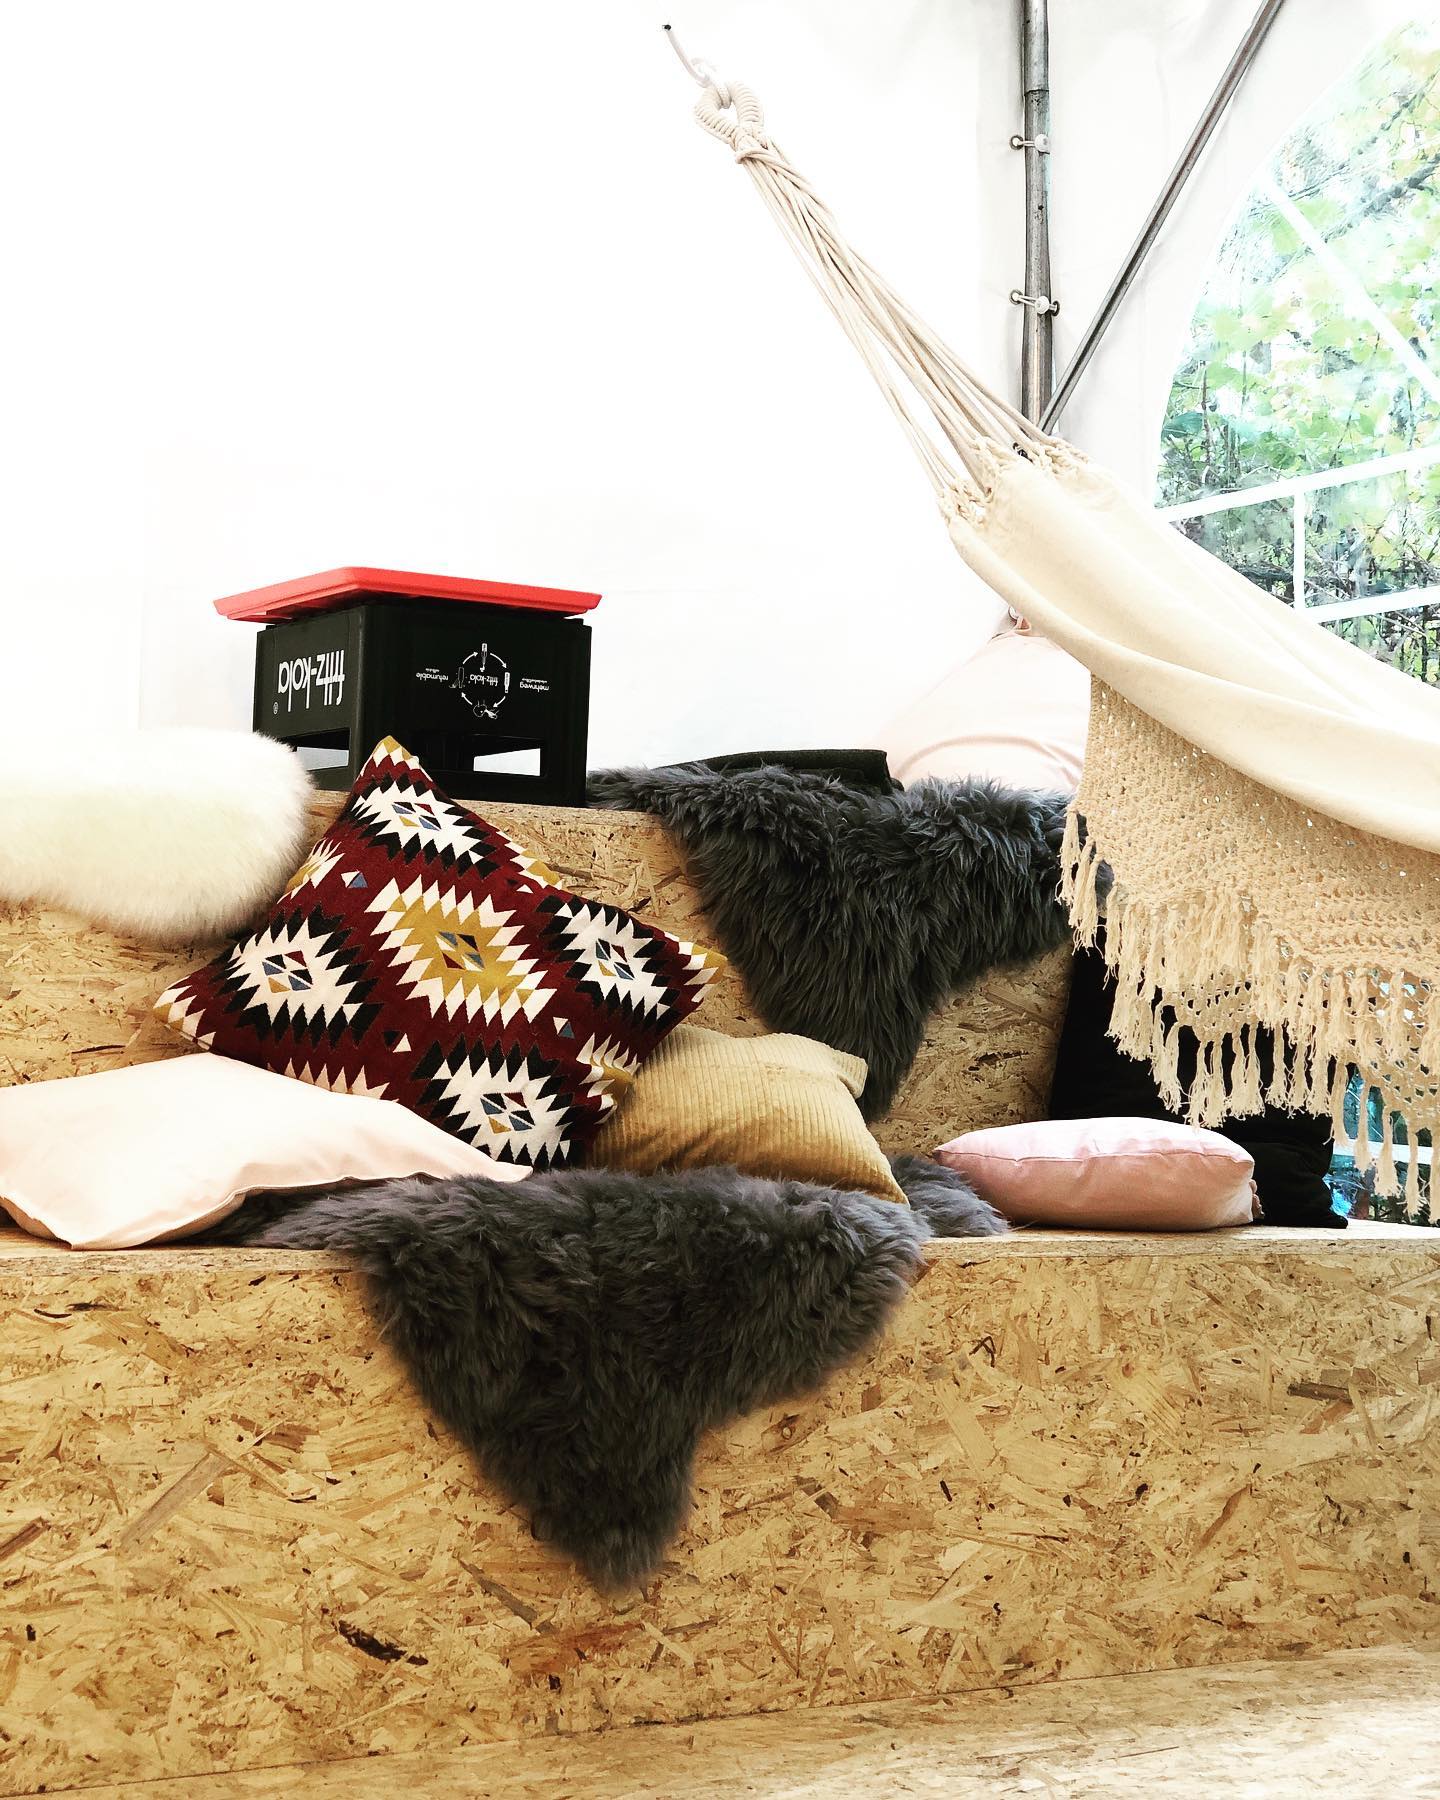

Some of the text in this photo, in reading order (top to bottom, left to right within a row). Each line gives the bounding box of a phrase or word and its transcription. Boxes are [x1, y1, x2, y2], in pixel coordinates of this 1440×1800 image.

[277, 649, 346, 713] fritz-kola
[415, 672, 449, 682] returnable
[469, 674, 499, 687] fritz-kola
[519, 681, 550, 693] mehrweg
